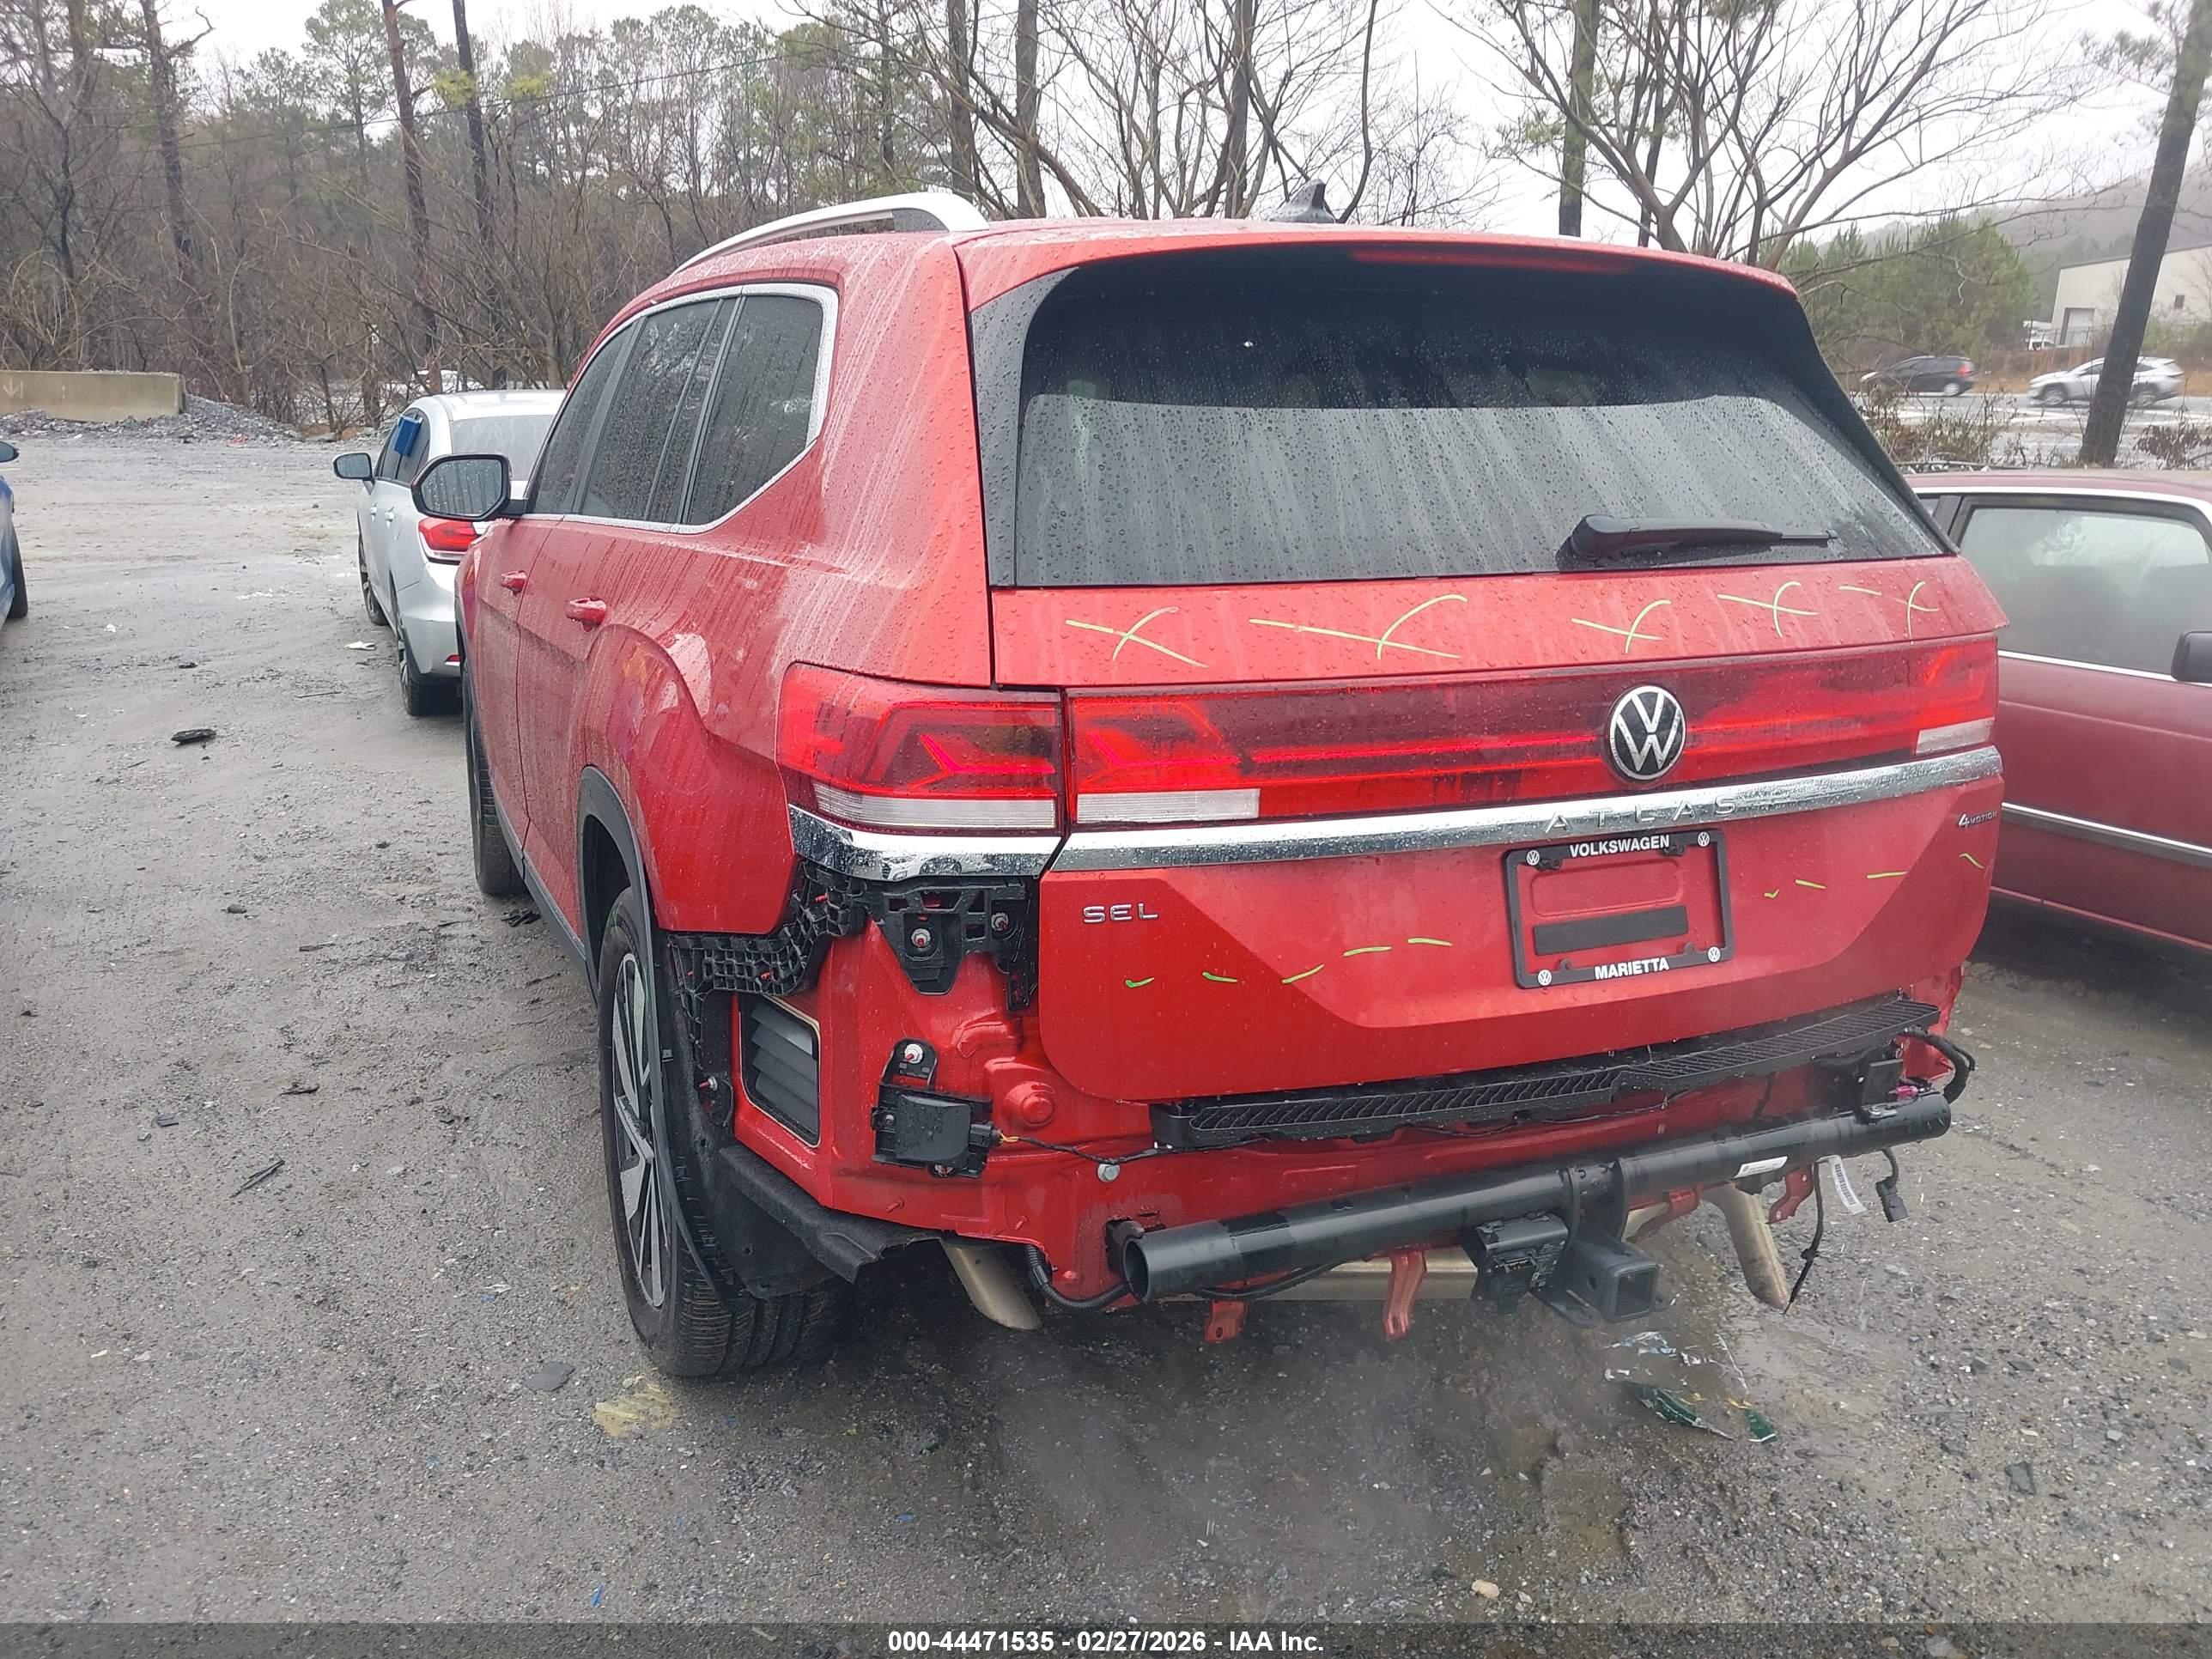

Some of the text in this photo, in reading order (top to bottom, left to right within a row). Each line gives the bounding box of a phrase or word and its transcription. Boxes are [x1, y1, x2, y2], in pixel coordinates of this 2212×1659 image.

[1545, 795, 1736, 834] ATLAS
[1959, 811, 1997, 828] 4MOTION
[1570, 835, 1670, 858] VOLKSWAGEN
[1083, 902, 1158, 924] SEL
[1595, 957, 1670, 981] MARIETTA
